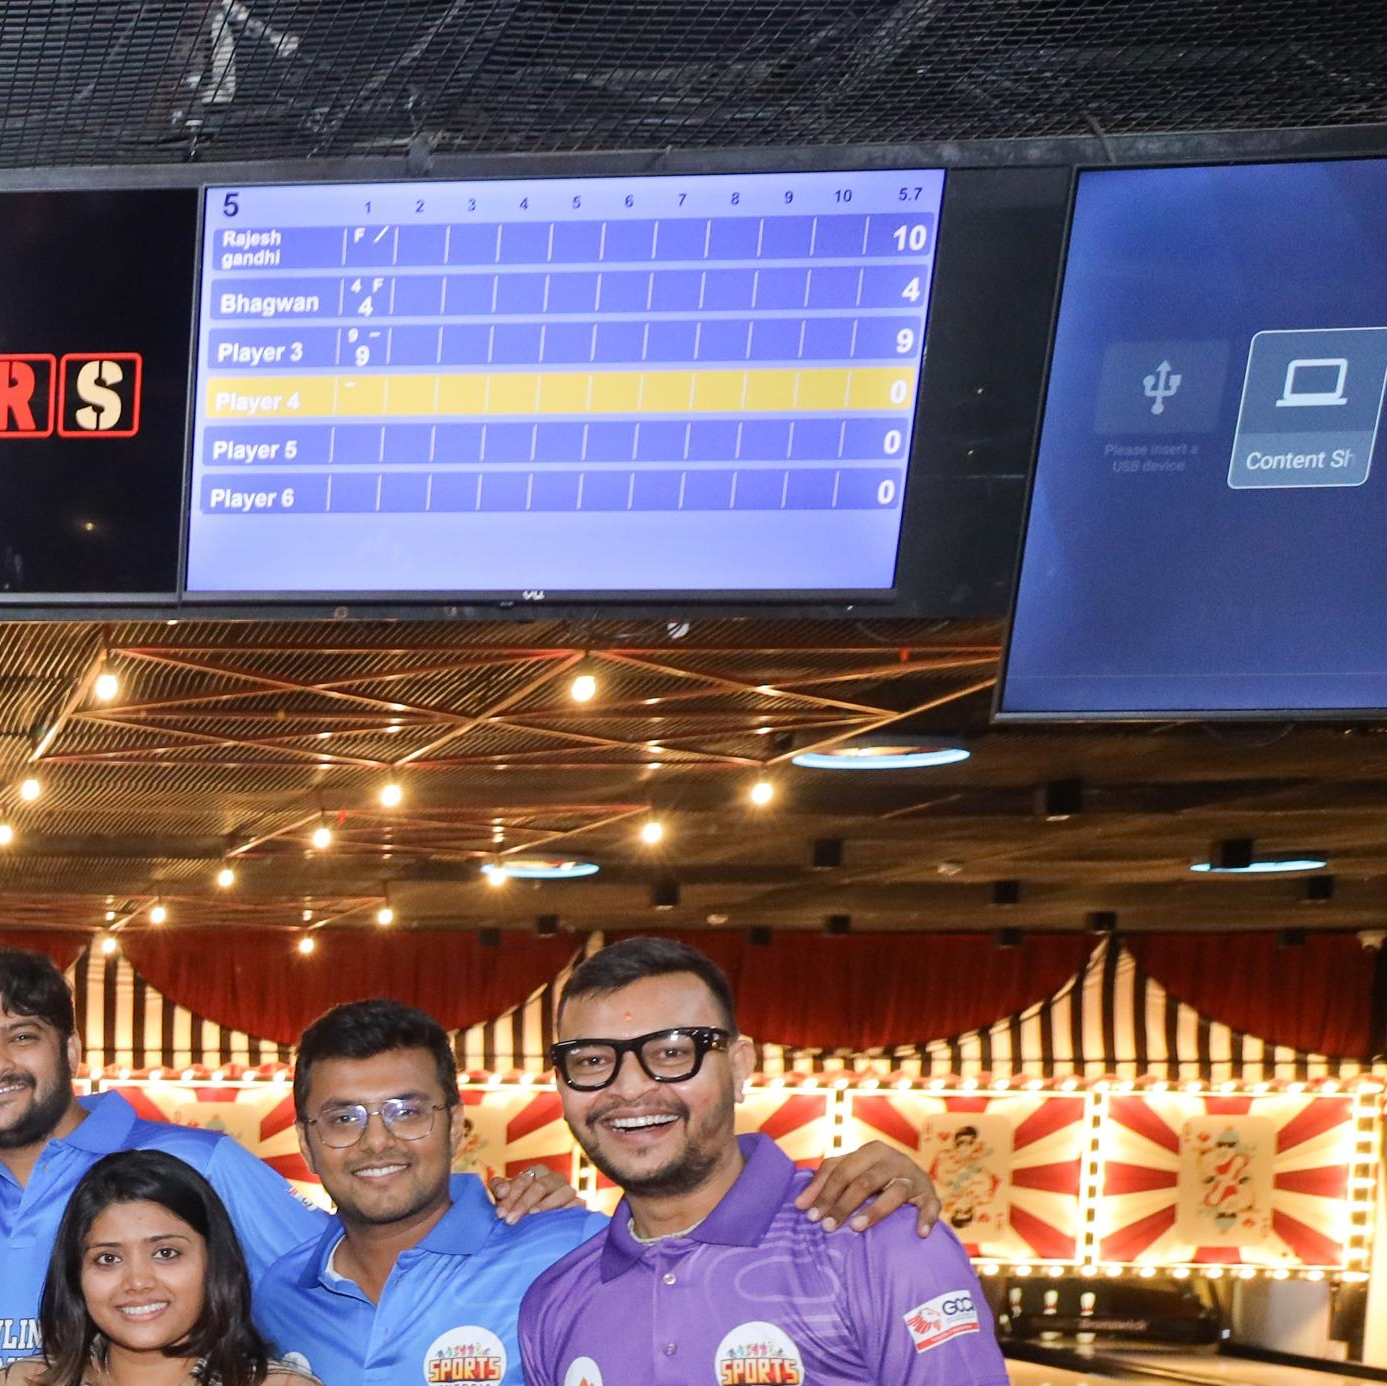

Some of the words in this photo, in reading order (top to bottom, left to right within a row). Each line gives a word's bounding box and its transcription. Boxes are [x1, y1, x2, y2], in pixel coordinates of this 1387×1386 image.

[223, 192, 239, 217] 5
[364, 200, 371, 213] 1
[416, 200, 425, 212] 2
[468, 199, 476, 212] 3
[520, 198, 529, 210] 4
[572, 196, 581, 208] 5
[625, 194, 634, 207] 6
[679, 193, 687, 206] 7
[731, 192, 740, 205] 8
[784, 190, 793, 203] 9
[835, 188, 852, 202] 10
[899, 187, 923, 201] 5.7
[223, 230, 281, 249] Rajesh
[354, 228, 365, 243] F
[892, 227, 926, 252] 10
[221, 249, 280, 269] gandhi
[220, 294, 319, 317] Bhagwan
[351, 279, 362, 293] 4
[372, 278, 384, 293] F
[901, 278, 920, 301] 4
[358, 296, 373, 316] 4
[217, 342, 285, 364] Player
[289, 341, 303, 361] 3
[348, 328, 358, 343] 9
[896, 329, 914, 353] 9
[355, 346, 370, 366] 9
[215, 391, 281, 413] Player
[286, 391, 301, 411] 4
[890, 380, 908, 404] 0
[212, 440, 279, 463] Player
[284, 440, 297, 459] 5
[883, 430, 902, 455] 0
[1246, 450, 1325, 471] Content
[209, 488, 276, 511] Player
[281, 488, 294, 508] 6
[877, 480, 895, 504] 0
[429, 1357, 501, 1383] SPORTS
[720, 1358, 800, 1386] SPORTS
